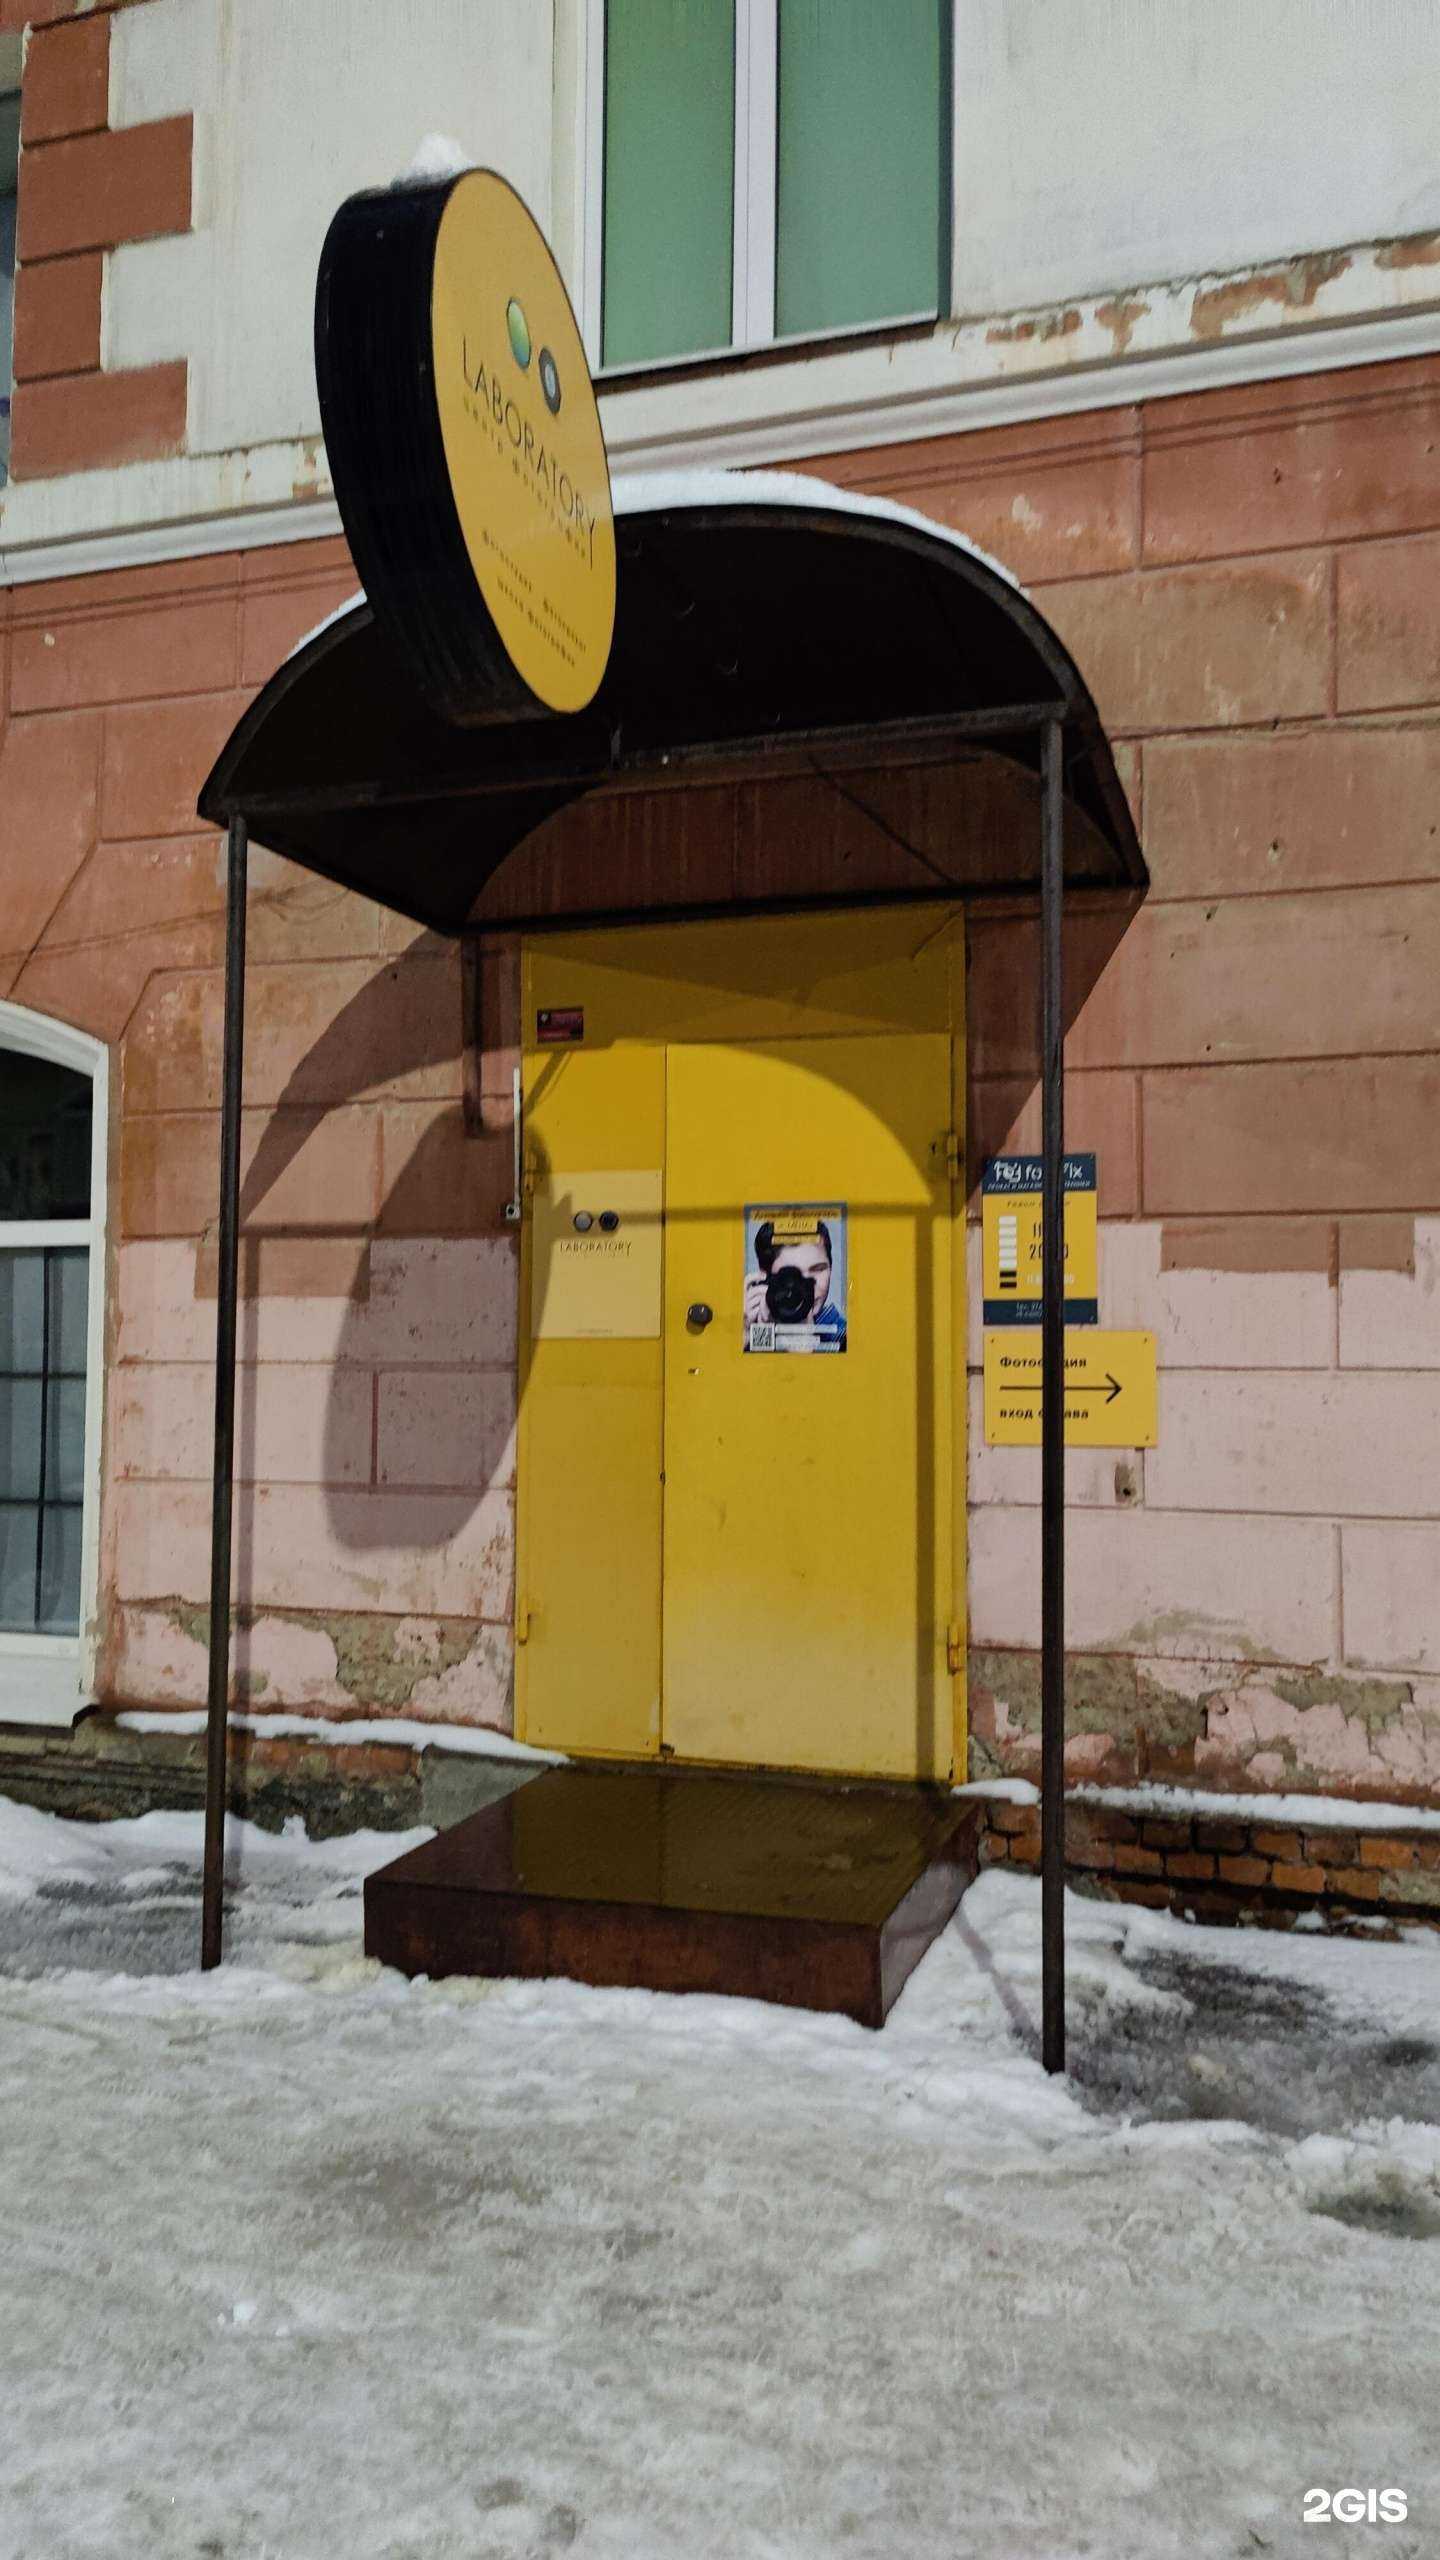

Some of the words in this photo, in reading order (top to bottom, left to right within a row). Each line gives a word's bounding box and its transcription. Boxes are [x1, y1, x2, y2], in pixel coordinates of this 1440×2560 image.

[463, 336, 596, 570] LABORATORY
[560, 1241, 632, 1256] LABORATORY
[1000, 1356, 1087, 1369] Фотосия
[1000, 1409, 1033, 1420] вход
[1038, 1409, 1089, 1419] сава
